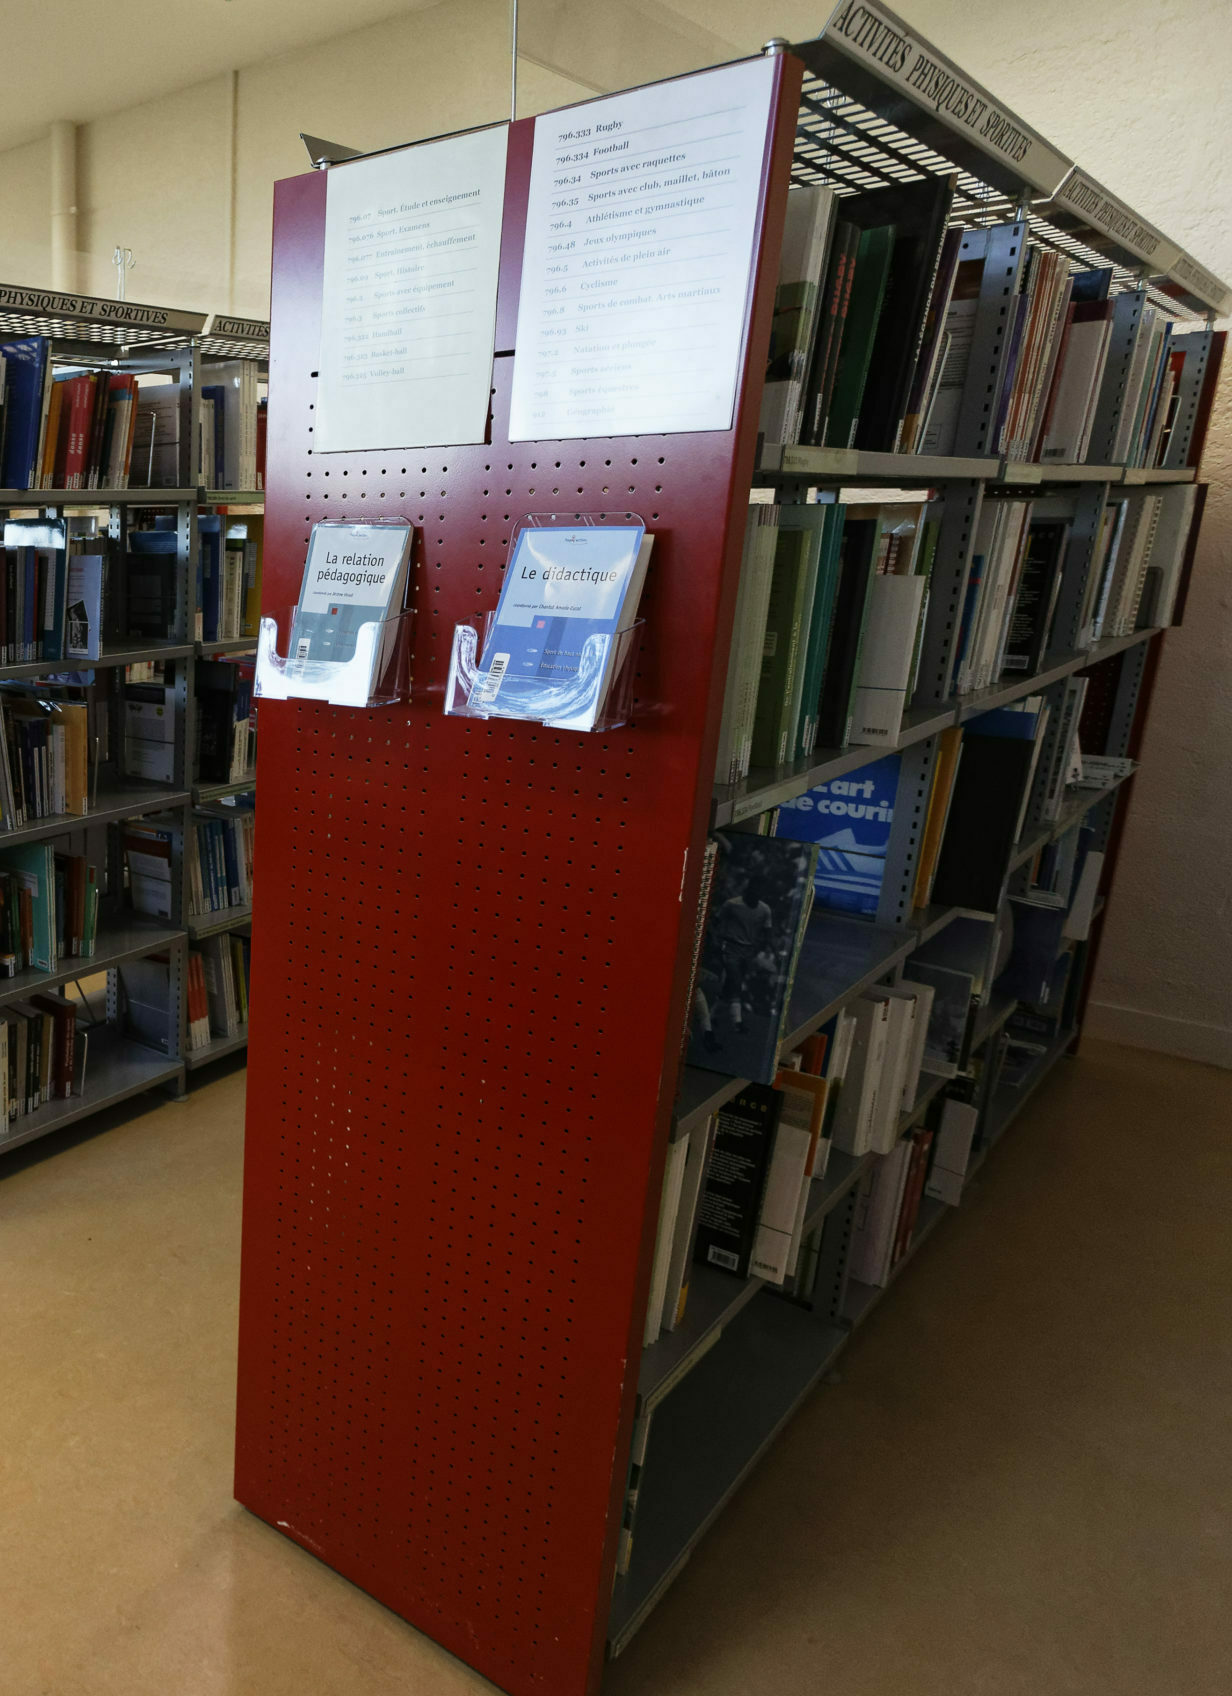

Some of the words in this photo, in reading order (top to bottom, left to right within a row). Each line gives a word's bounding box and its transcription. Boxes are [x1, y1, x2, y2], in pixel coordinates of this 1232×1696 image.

[832, 0, 913, 73] ACTIVITÉS
[905, 54, 974, 112] PHYSIQUES
[968, 98, 988, 128] ET
[980, 109, 1033, 163] SPORTIVES
[558, 128, 591, 143] 796.333
[595, 120, 624, 133] Rugby
[556, 151, 589, 165] 796.334
[593, 141, 629, 156] Football
[553, 175, 582, 187] 796.34
[590, 166, 619, 180] Sports
[620, 162, 641, 173] avec
[642, 152, 687, 170] raquettes
[429, 188, 481, 206] enseignement
[551, 197, 579, 210] 796.35
[587, 188, 617, 203] Sports
[617, 186, 638, 197] avec
[702, 167, 731, 180] bâton
[585, 209, 634, 225] Athlétisme
[634, 206, 643, 216] et
[644, 196, 705, 216] gymnastique
[583, 234, 605, 247] Jeux
[605, 228, 657, 245] olympiques
[582, 255, 619, 270] Activités
[620, 252, 632, 263] de
[633, 249, 656, 264] plein
[657, 246, 671, 257] air
[580, 278, 619, 292] Cyclisme
[577, 298, 607, 313] Sports
[607, 297, 619, 308] de
[678, 286, 721, 299] martiaux
[78, 301, 96, 315] ET
[98, 304, 169, 325] SPORTIVES
[215, 320, 270, 337] ACTIVITÉS
[326, 551, 338, 564] La
[342, 552, 385, 567] relation
[317, 568, 386, 586] pédagogique
[521, 566, 537, 580] Le
[542, 567, 617, 585] didactique
